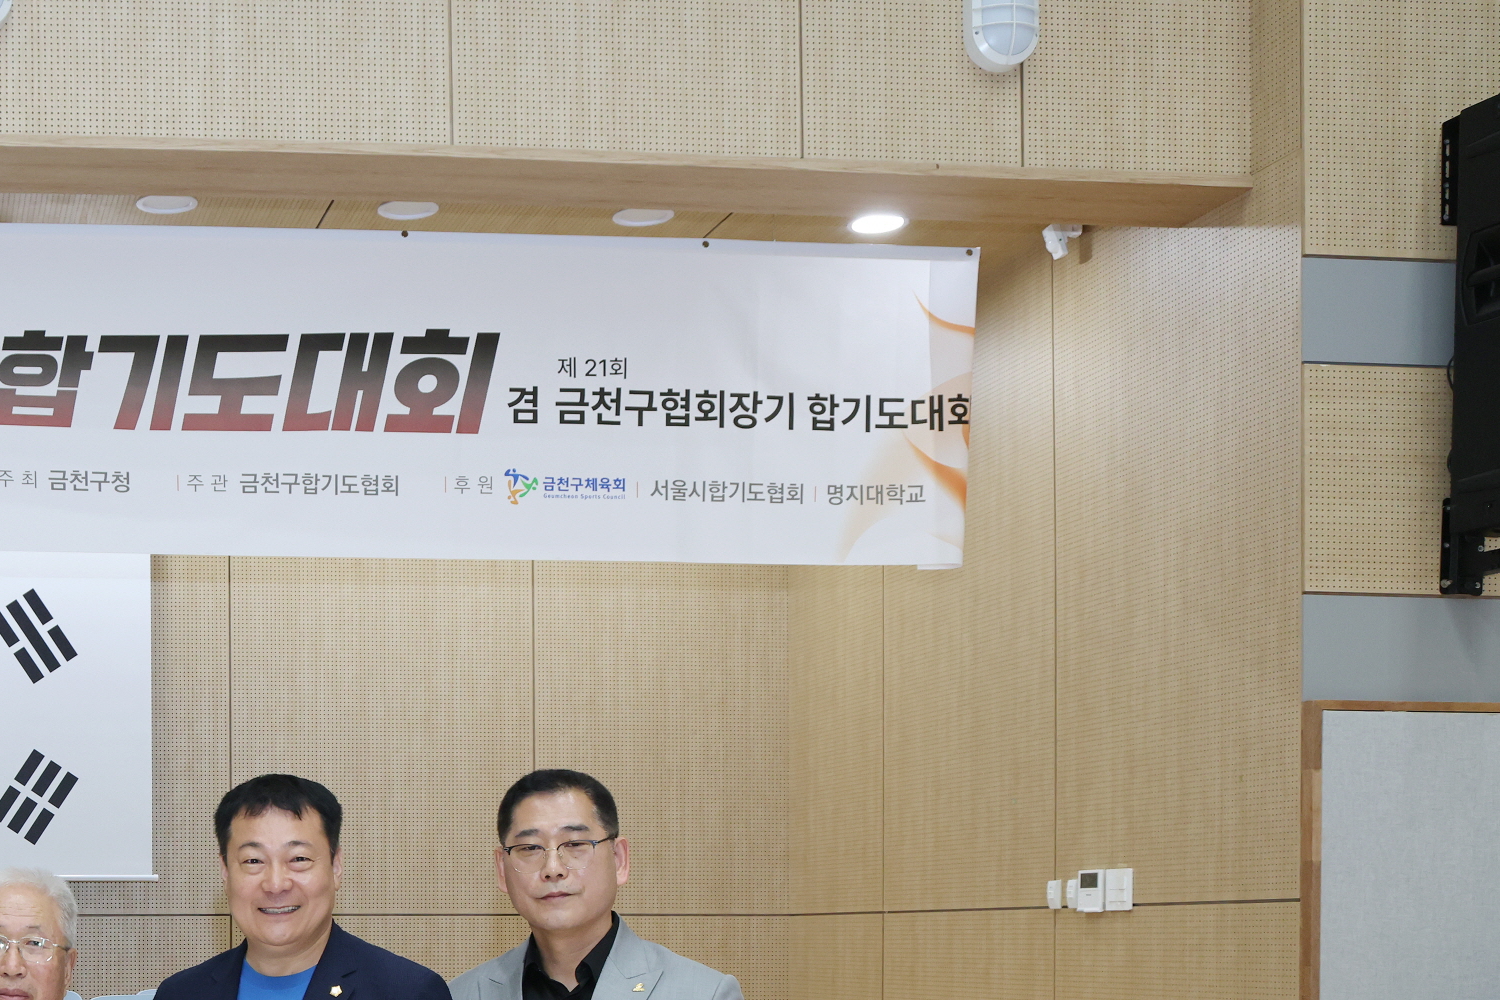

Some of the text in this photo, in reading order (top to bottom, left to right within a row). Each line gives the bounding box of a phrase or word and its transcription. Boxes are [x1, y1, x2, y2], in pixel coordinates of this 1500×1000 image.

[557, 356, 628, 380] 제 21회
[506, 385, 539, 425] 겸
[554, 386, 795, 431] 금천구협회장기
[47, 469, 131, 494] 금천구청
[239, 472, 399, 497] 금천구합기도협회
[542, 476, 626, 493] 금천구체육회
[649, 479, 804, 505] 서울시합기도협회
[826, 483, 927, 506] 명지대학교
